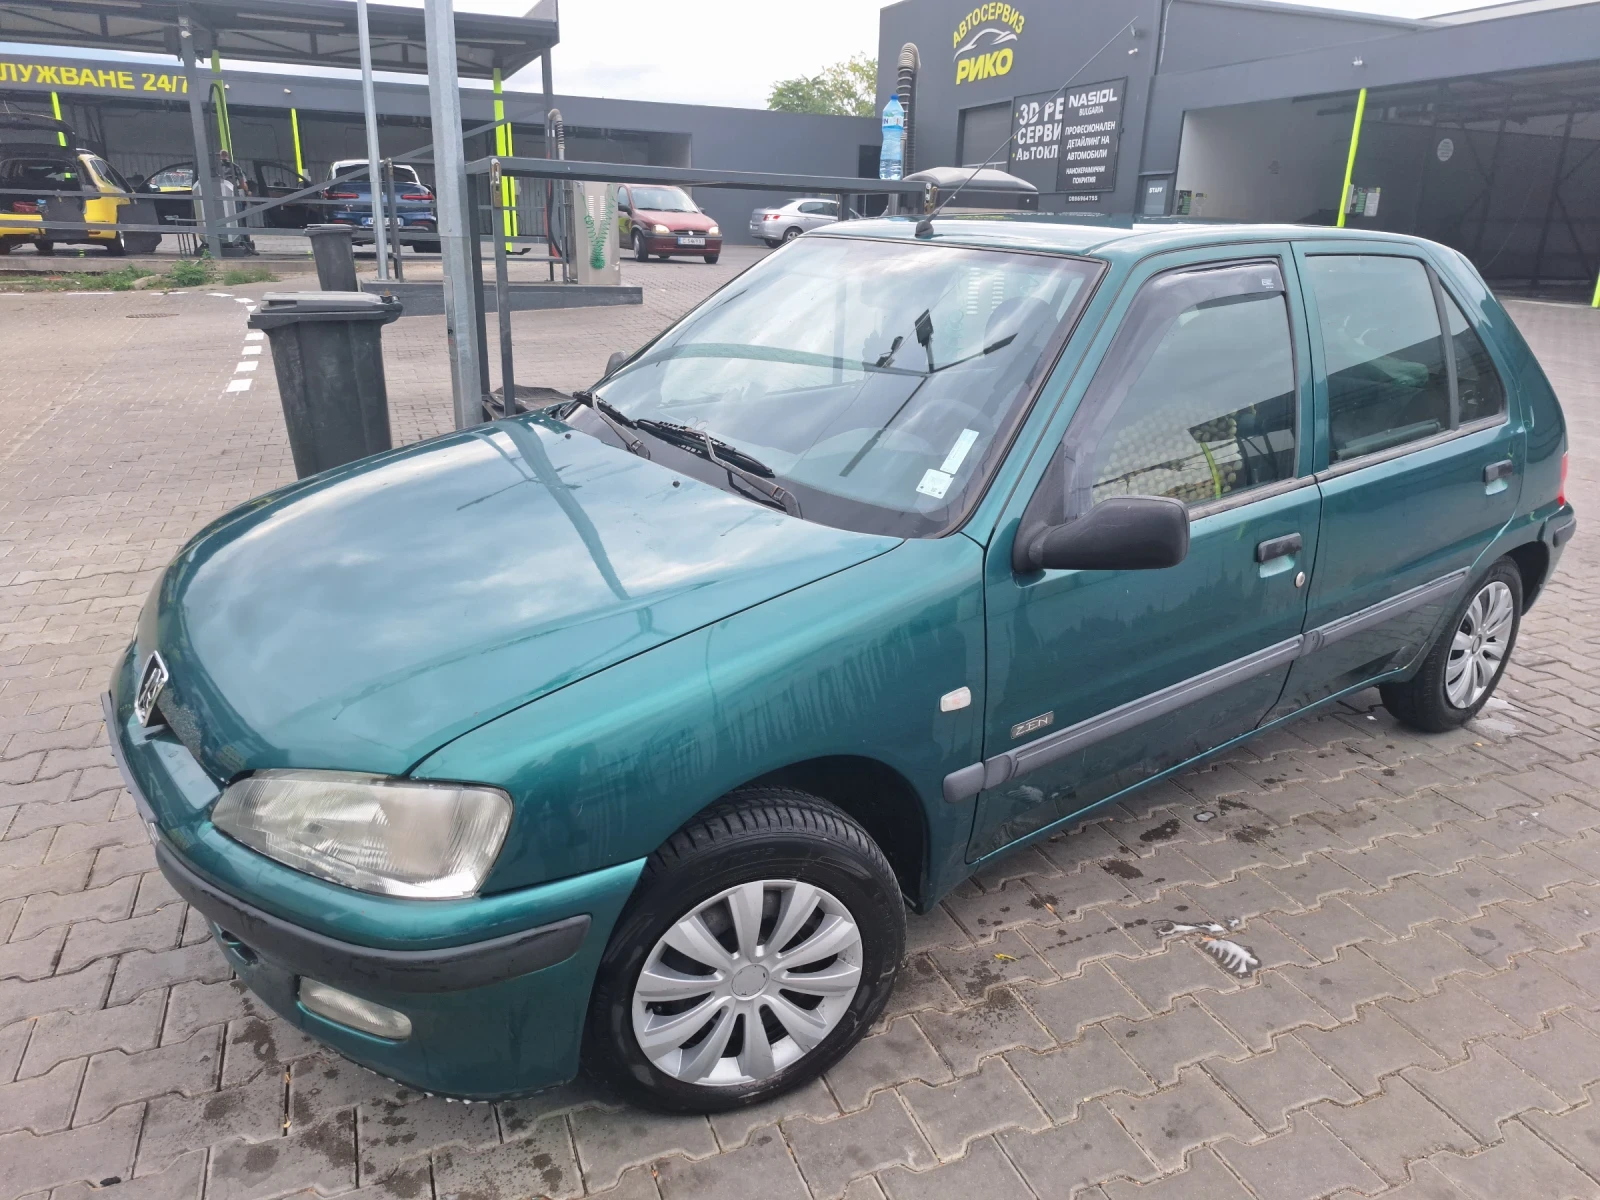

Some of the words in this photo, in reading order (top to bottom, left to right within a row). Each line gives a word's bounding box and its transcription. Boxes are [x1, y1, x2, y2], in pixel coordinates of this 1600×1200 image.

[953, 2, 1025, 49] АВТОСЕРВИЗ
[956, 48, 1013, 85] РИКО
[0, 63, 135, 90] ЛУЖВАНЕ
[141, 73, 188, 94] 24/7
[1068, 88, 1118, 108] NASIOL
[1019, 102, 1040, 125] 3D
[1079, 105, 1104, 116] BULGARIA
[1065, 121, 1116, 135] ПРОФЕСИОНАЛЕН
[1066, 136, 1101, 150] ДЕТАЙЛИНГ
[1101, 135, 1110, 145] НА
[1066, 149, 1108, 161] АВТОМОБИЛИ
[1015, 716, 1048, 736] ZEN
